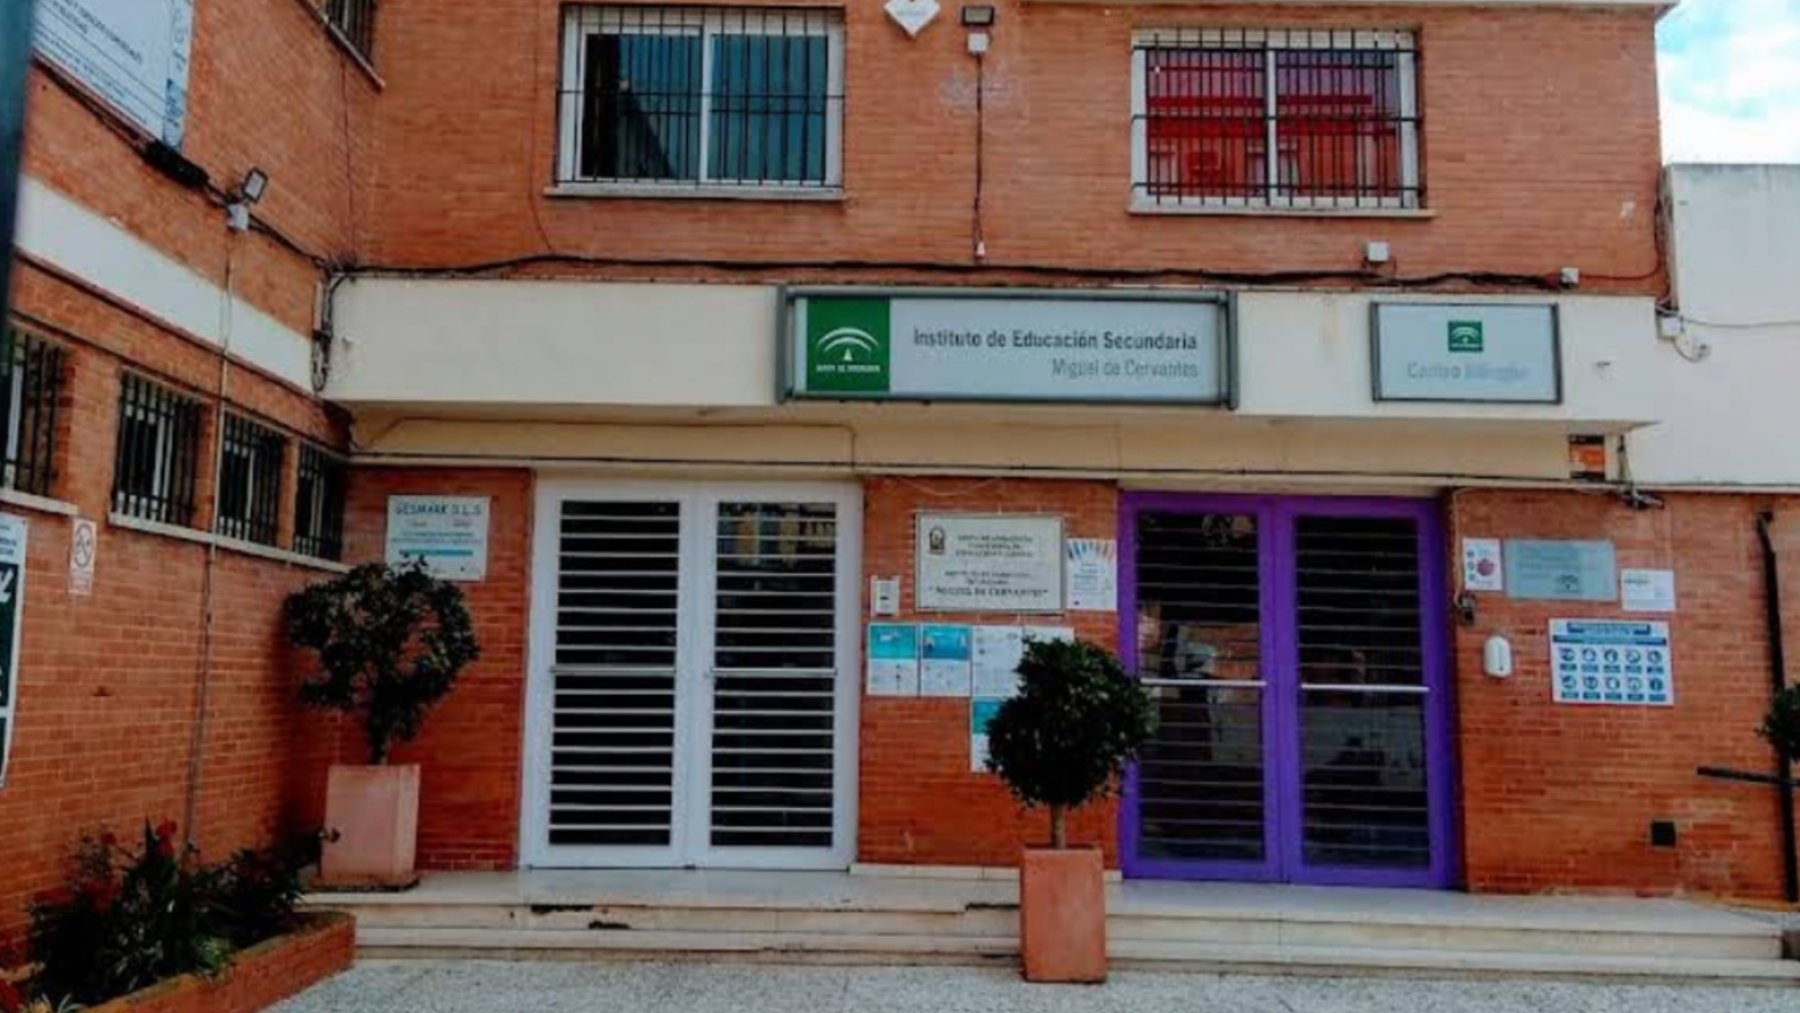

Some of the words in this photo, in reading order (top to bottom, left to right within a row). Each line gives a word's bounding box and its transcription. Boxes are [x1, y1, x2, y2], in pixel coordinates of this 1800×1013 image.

[913, 326, 983, 348] Instituto
[986, 328, 1006, 348] de
[1012, 328, 1098, 349] Educación
[1103, 331, 1198, 350] Secundaria
[1052, 358, 1099, 379] Miguel
[1125, 360, 1199, 379] Cervantes
